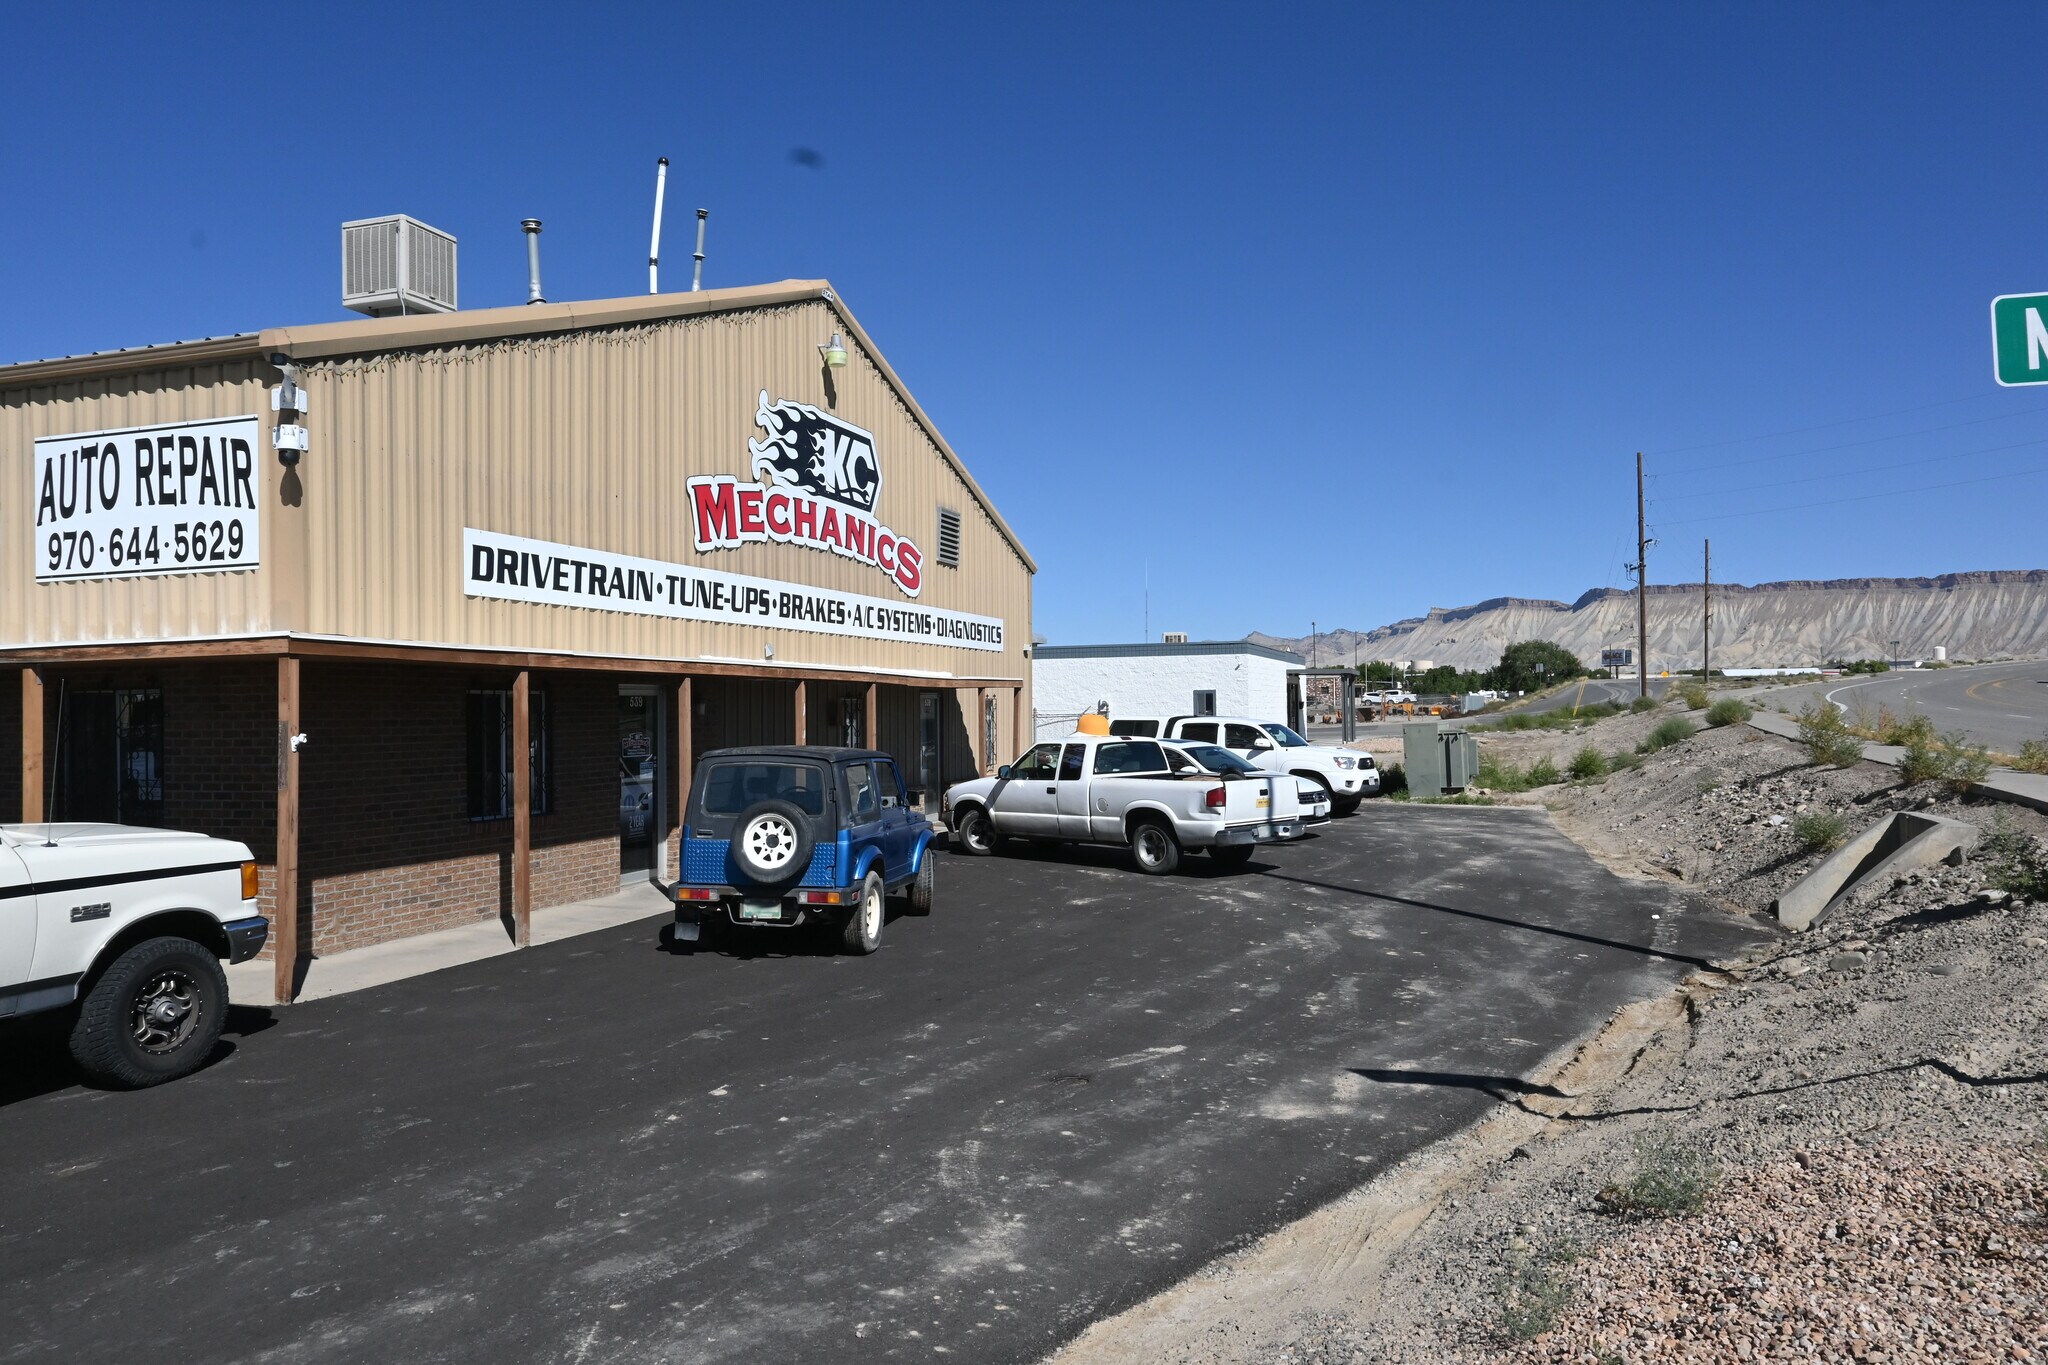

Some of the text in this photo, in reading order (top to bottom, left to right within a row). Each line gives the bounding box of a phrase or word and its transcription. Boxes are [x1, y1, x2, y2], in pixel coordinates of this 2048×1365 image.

[36, 434, 256, 526] AUTO REPAIR
[817, 427, 876, 496] KC
[692, 483, 921, 591] MECHANICS
[471, 543, 654, 602] DRIVETRAIN
[665, 574, 770, 616] TUNE-UPS
[778, 598, 845, 625] BRAKES
[876, 609, 932, 636] SYSTEMS
[936, 616, 1003, 645] DIAGNOSTICS
